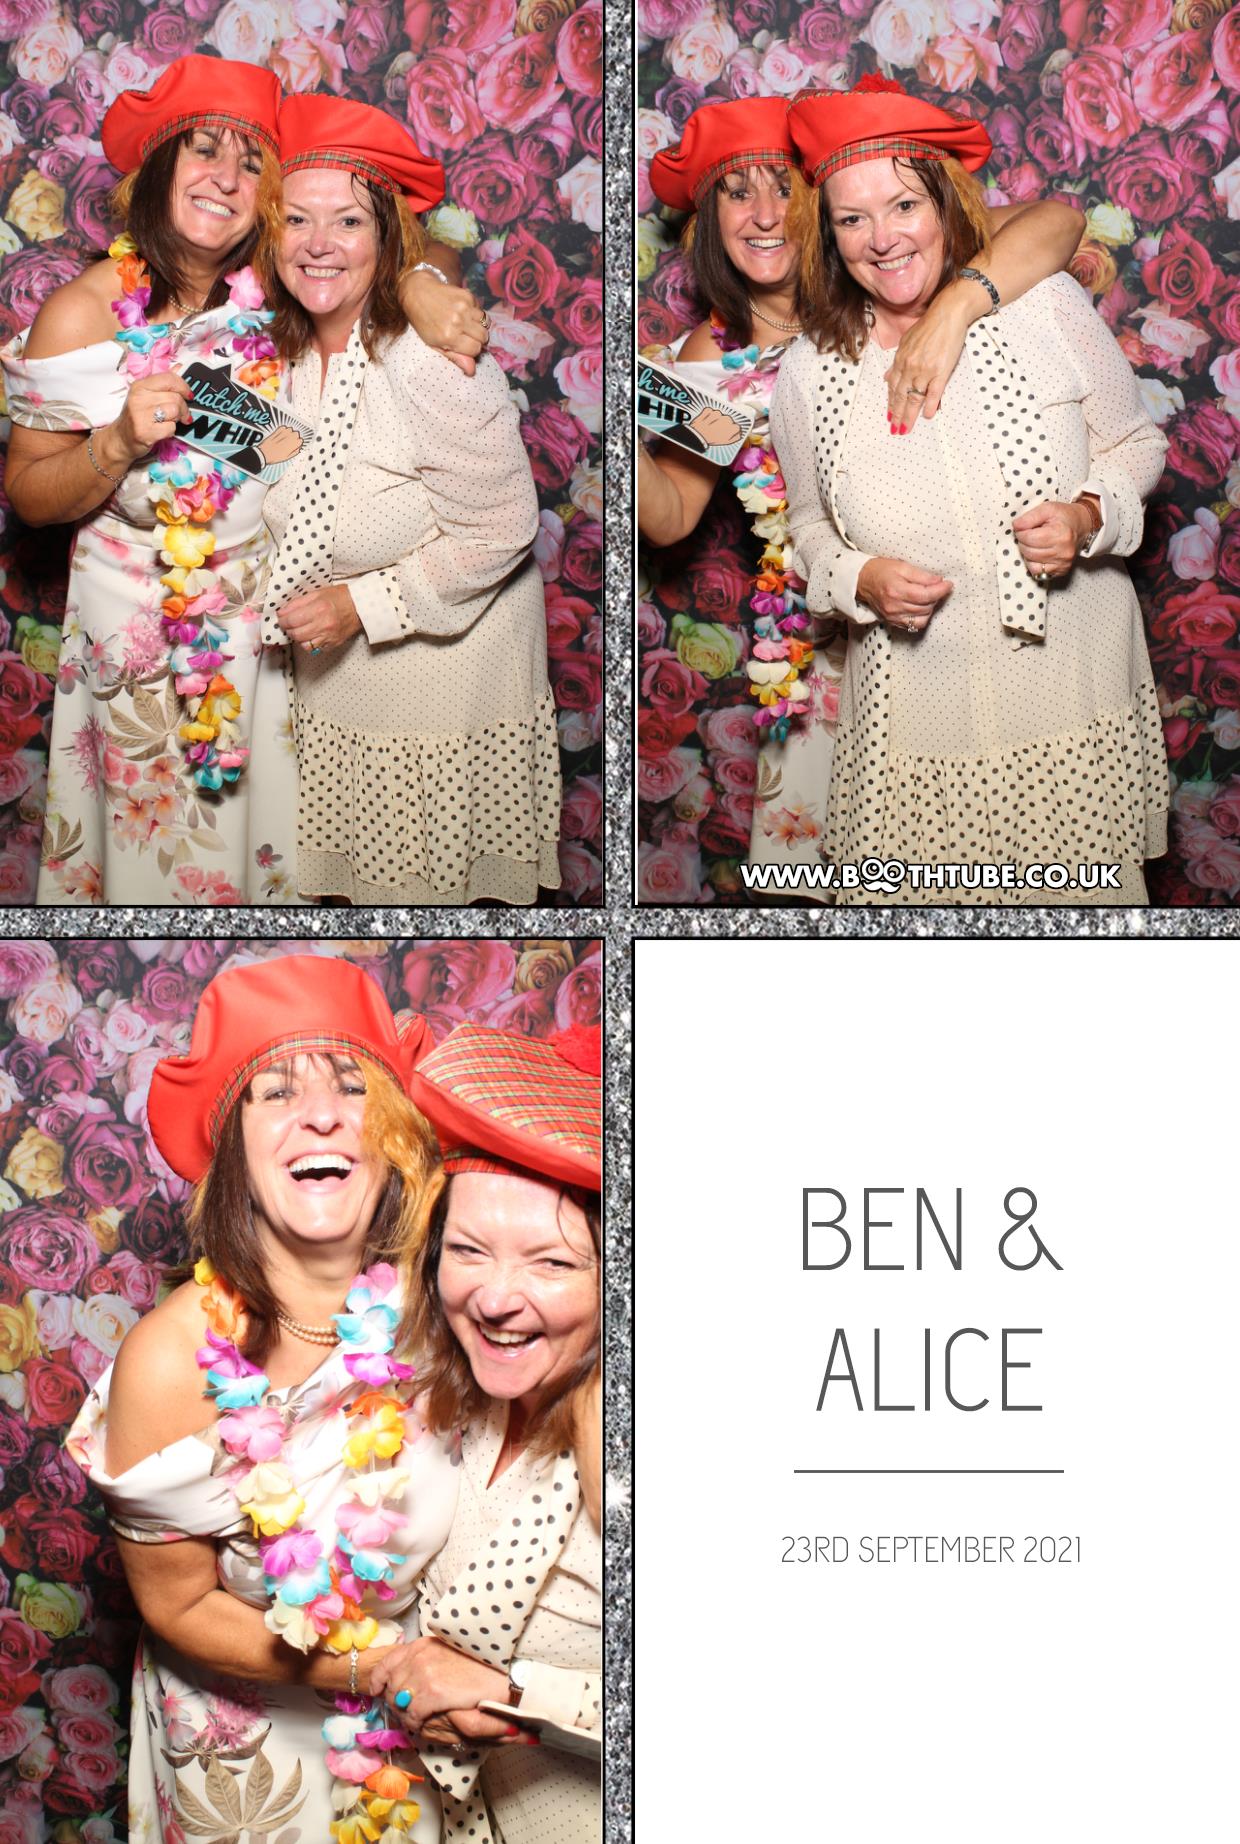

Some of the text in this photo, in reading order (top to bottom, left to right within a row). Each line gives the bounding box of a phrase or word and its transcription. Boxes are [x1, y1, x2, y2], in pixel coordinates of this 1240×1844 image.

[658, 384, 691, 404] me
[244, 406, 272, 424] me
[638, 395, 692, 423] HIP
[175, 414, 264, 446] WHIP
